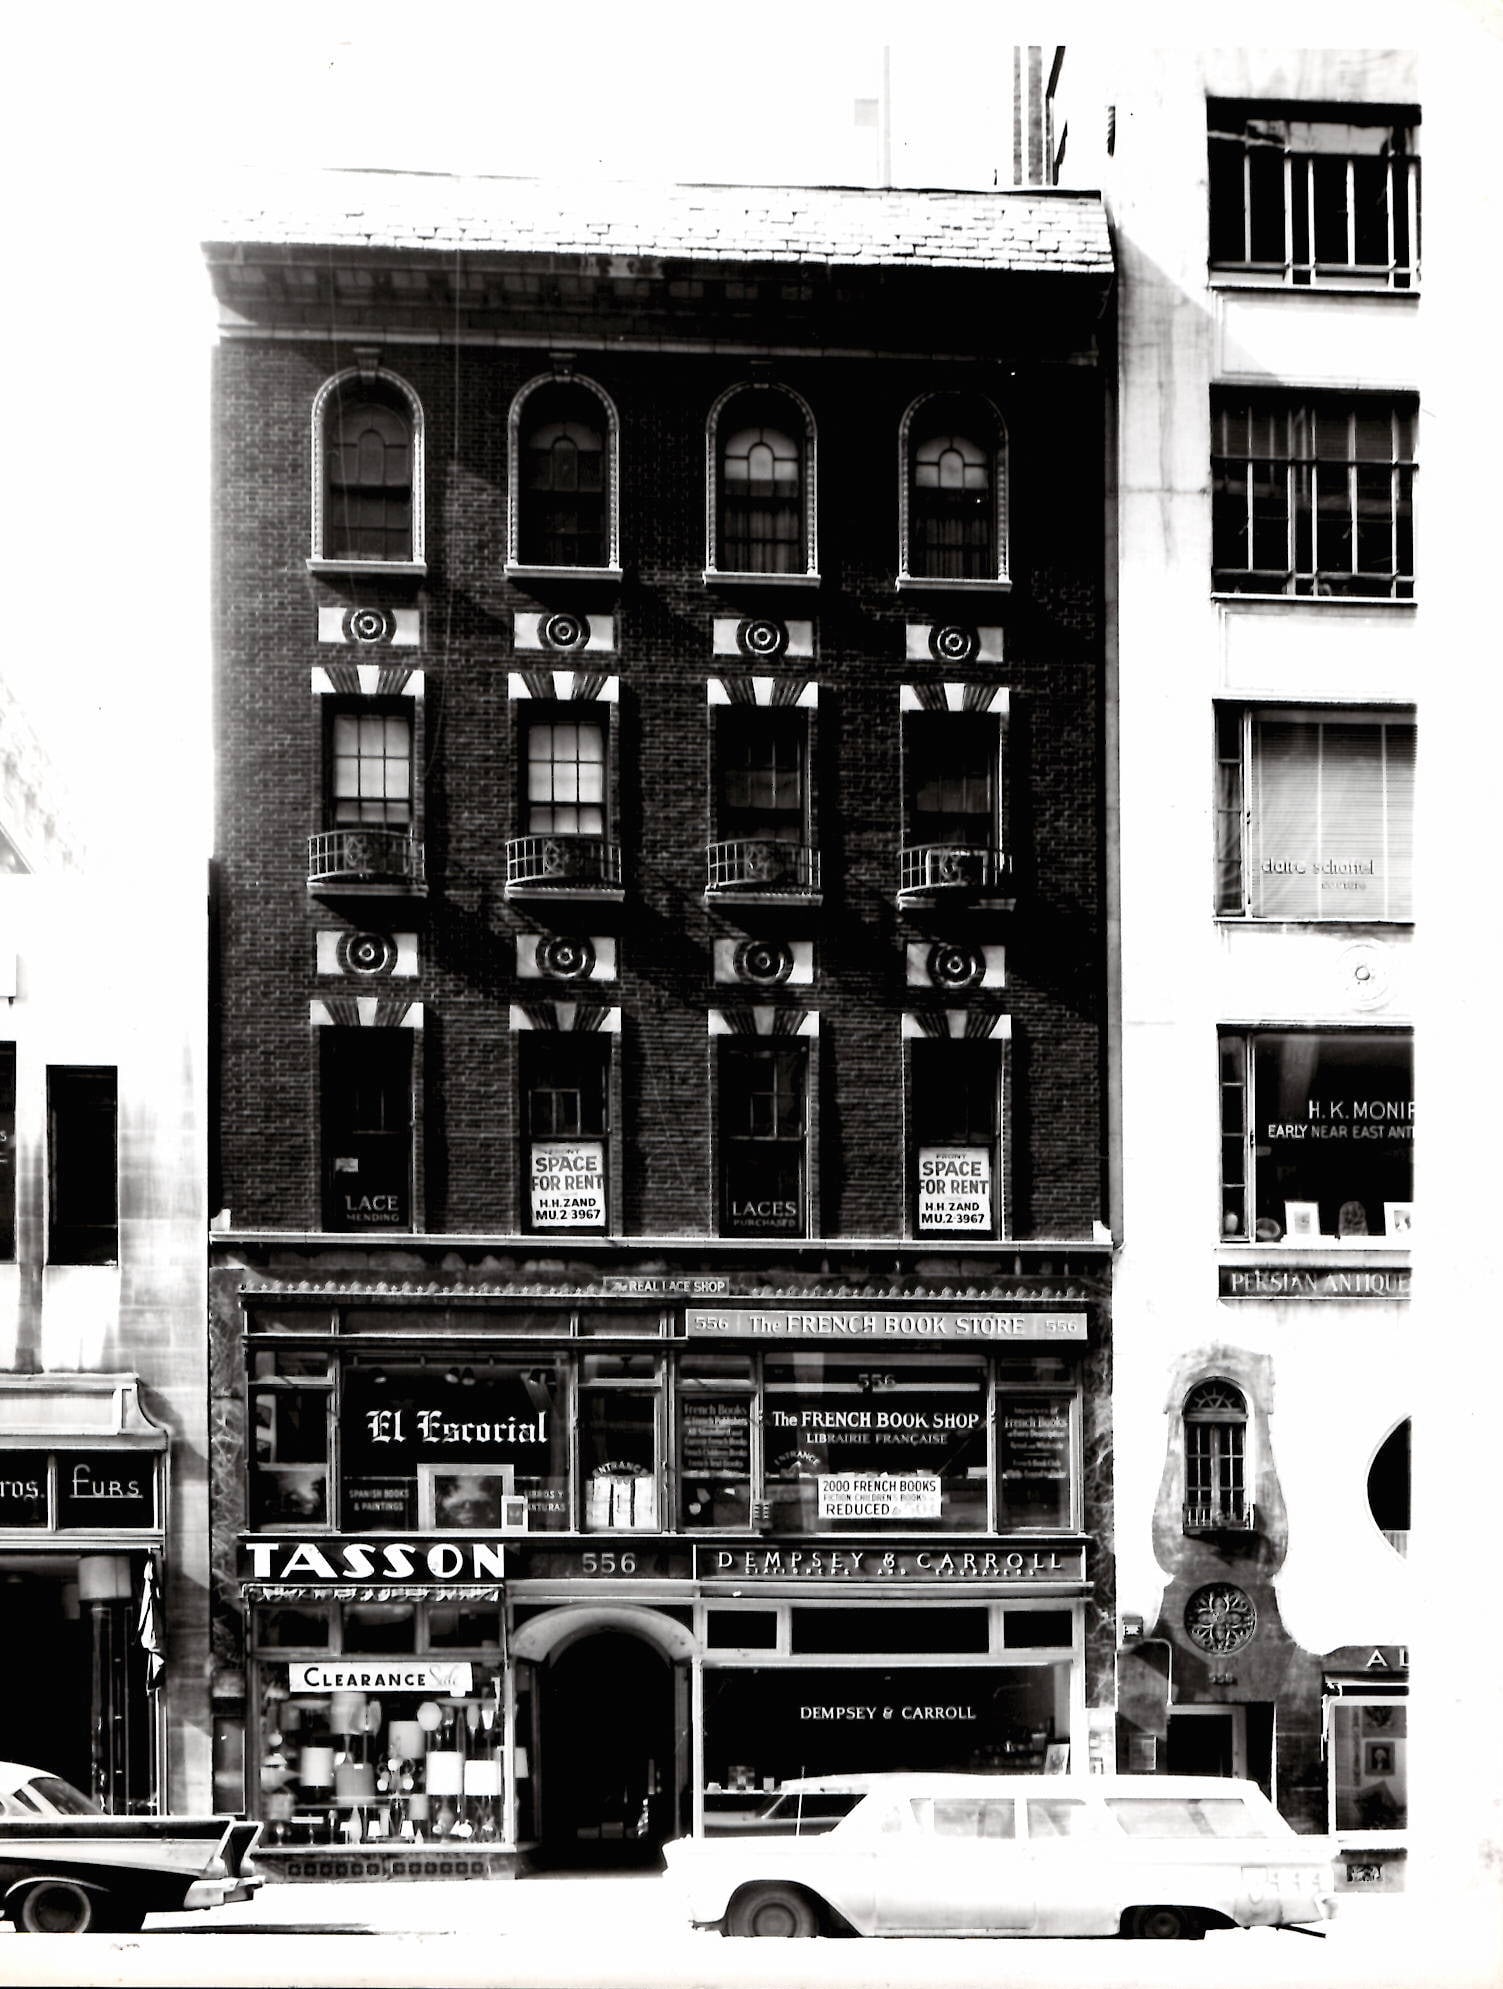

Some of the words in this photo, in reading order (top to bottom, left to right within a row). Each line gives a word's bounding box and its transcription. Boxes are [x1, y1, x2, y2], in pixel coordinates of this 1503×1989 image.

[1268, 1124, 1308, 1139] EARLY
[1312, 1125, 1348, 1140] NEAR
[1352, 1125, 1384, 1140] EAST
[535, 1156, 598, 1172] SPACE
[922, 1160, 982, 1176] SPACE
[532, 1175, 560, 1192] FOR
[564, 1174, 602, 1190] RENT
[920, 1179, 946, 1195] FOR
[950, 1179, 989, 1195] RENT
[344, 1194, 400, 1211] LACE
[732, 1200, 797, 1216] LACES
[628, 1280, 660, 1292] REAL
[662, 1281, 690, 1292] LACE
[694, 1281, 726, 1293] SHOP
[1230, 1272, 1318, 1293] PERSIAN
[694, 1316, 729, 1330] 556
[748, 1316, 780, 1334] The
[786, 1315, 877, 1334] FRENCH
[884, 1316, 946, 1334] BOOK
[955, 1316, 1025, 1335] STORE
[1045, 1320, 1078, 1333] 556
[366, 1410, 406, 1444] El
[416, 1410, 548, 1444] Escorial
[772, 1410, 798, 1427] The
[801, 1411, 872, 1428] FRENCH
[875, 1412, 929, 1428] BOOK
[933, 1412, 980, 1430] SHOP
[806, 1432, 871, 1446] LIBRAIRIE
[874, 1433, 949, 1448] FRANÇAISE
[774, 1450, 820, 1466] ENTRANCE
[348, 1488, 382, 1499] SPANISH
[384, 1488, 410, 1499] BOOKS
[823, 1480, 850, 1492] 2000
[854, 1480, 896, 1492] FRENCH
[900, 1480, 937, 1492] BOOKS
[824, 1494, 852, 1502] FICTION
[362, 1501, 404, 1512] PAINTINGS
[826, 1503, 890, 1516] REDUCED
[246, 1543, 504, 1578] TASSON
[580, 1552, 636, 1575] 556
[718, 1551, 864, 1569] DEMPSEY
[882, 1552, 895, 1568] &
[916, 1552, 1062, 1570] CARROLL
[304, 1666, 426, 1688] CLEARANCE
[800, 1706, 878, 1720] DEMPSEY
[882, 1706, 894, 1720] &
[901, 1706, 977, 1720] CARROLL
